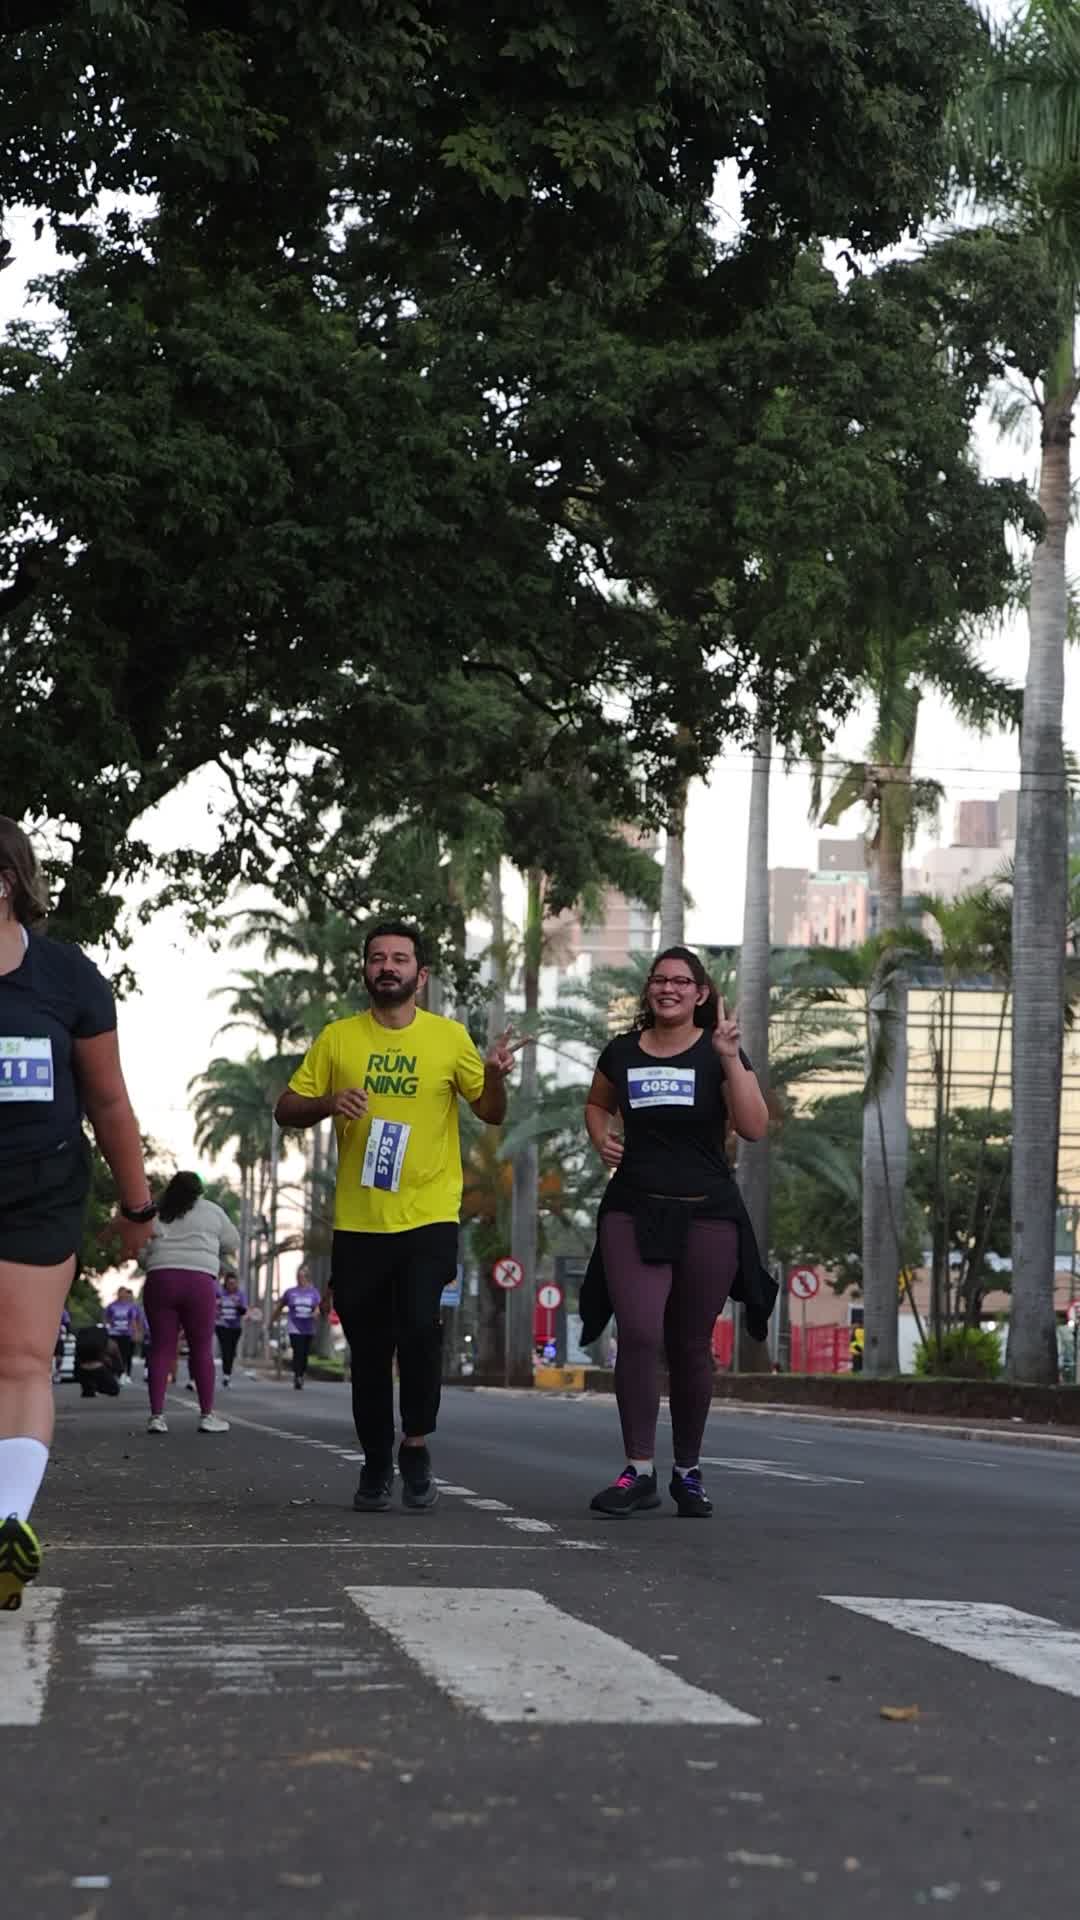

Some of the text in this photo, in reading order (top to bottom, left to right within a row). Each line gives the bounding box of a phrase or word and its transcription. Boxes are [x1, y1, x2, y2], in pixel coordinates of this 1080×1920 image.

[367, 1054, 417, 1073] RUN
[364, 1075, 419, 1095] NING
[641, 1081, 679, 1093] 6056
[377, 1136, 394, 1175] 5795
